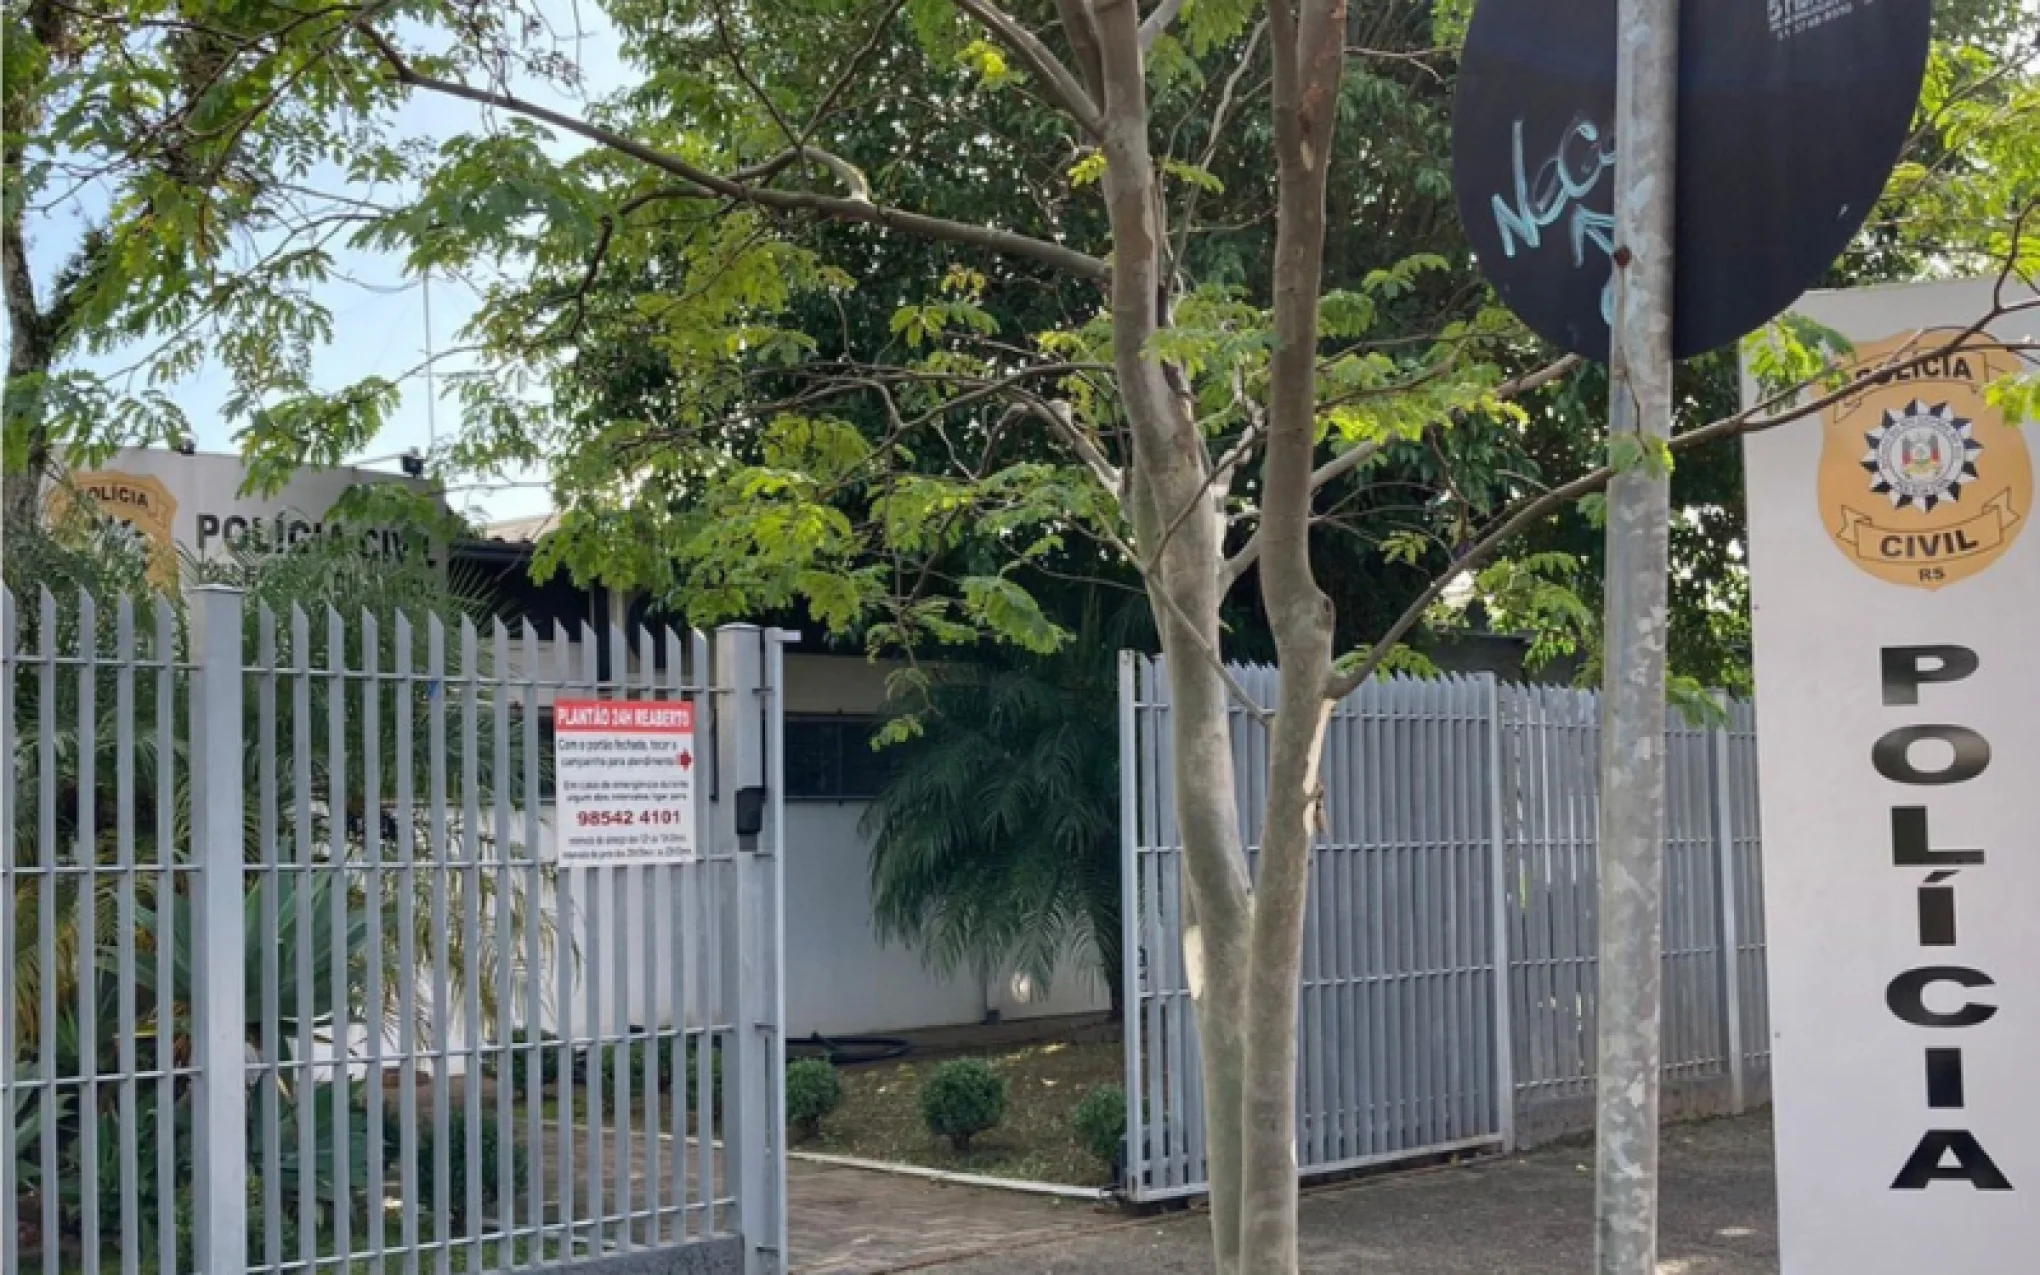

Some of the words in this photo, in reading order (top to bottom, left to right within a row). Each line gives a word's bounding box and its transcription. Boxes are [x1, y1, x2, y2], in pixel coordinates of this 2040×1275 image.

[1880, 529, 1979, 557] CIVIL
[1919, 567, 1946, 582] RS
[557, 704, 610, 725] PLANTÃO
[577, 809, 634, 826] 98542
[639, 809, 680, 825] 4101
[1872, 644, 2015, 1191] POLÍCIA
